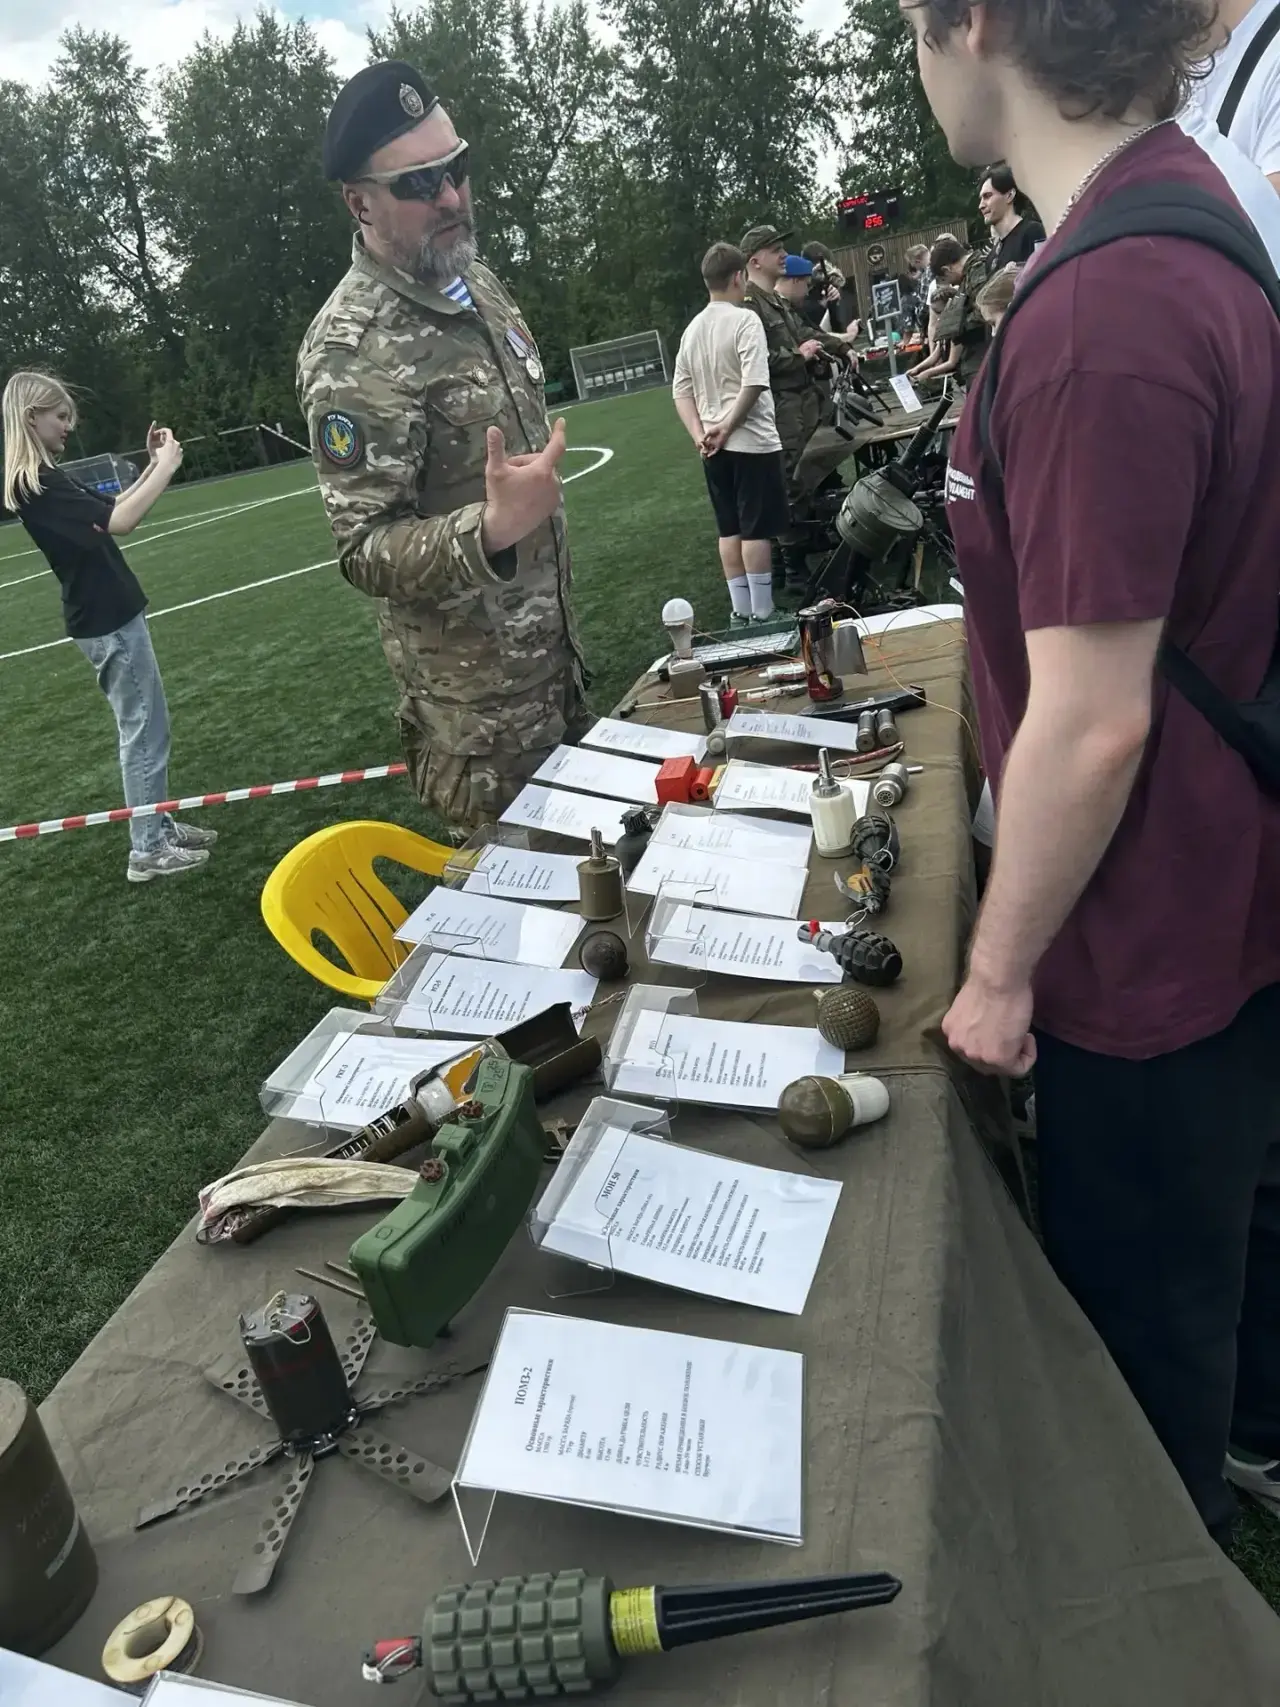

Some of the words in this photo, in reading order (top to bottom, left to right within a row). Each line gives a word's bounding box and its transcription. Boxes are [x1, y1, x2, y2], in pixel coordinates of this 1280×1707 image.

[600, 1180, 617, 1198] МОН
[610, 1171, 621, 1180] 50
[513, 1366, 532, 1405] ПОМЗ-2
[524, 1413, 541, 1451] Основные
[535, 1358, 555, 1412] характеристики
